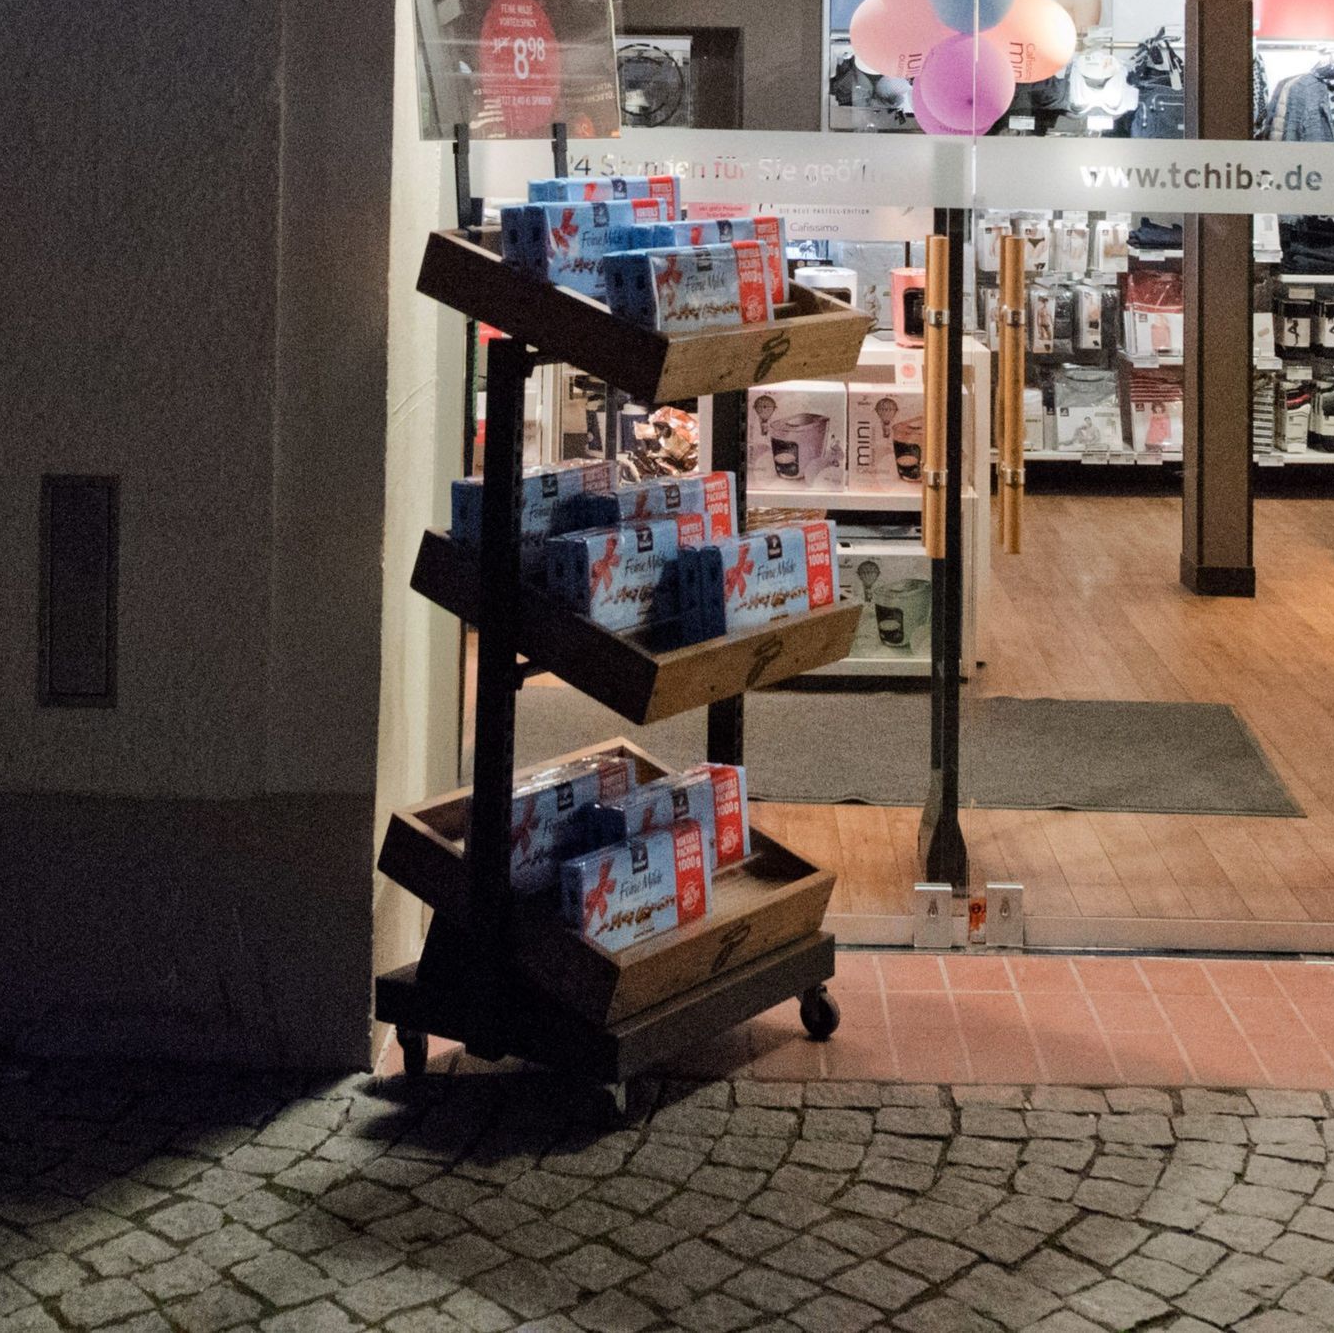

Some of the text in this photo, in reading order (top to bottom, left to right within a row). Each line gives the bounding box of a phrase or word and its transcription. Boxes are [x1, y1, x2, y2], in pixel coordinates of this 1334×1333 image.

[714, 154, 750, 180] für
[1078, 161, 1323, 191] www.tchibo.de
[789, 221, 840, 233] Cafissimo
[856, 420, 871, 467] mini
